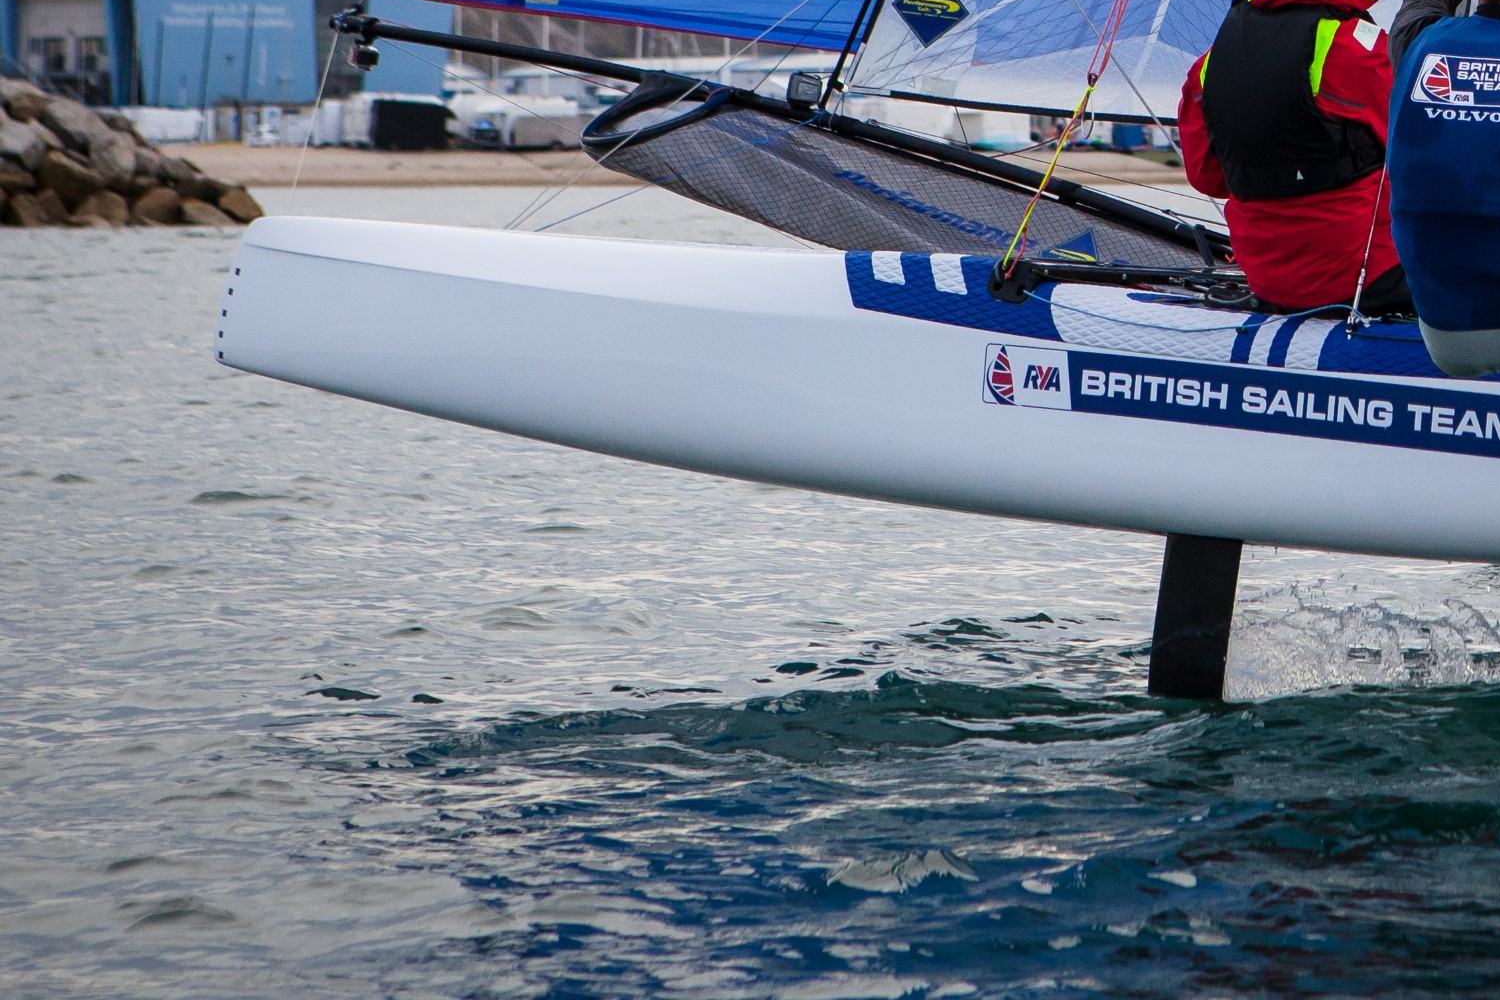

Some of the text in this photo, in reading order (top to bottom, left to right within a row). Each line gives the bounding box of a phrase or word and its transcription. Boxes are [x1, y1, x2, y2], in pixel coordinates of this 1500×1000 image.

[1453, 93, 1470, 102] RYA
[1023, 364, 1062, 392] RYA
[1080, 368, 1229, 410] BRITISH
[1241, 390, 1394, 429] SAILING
